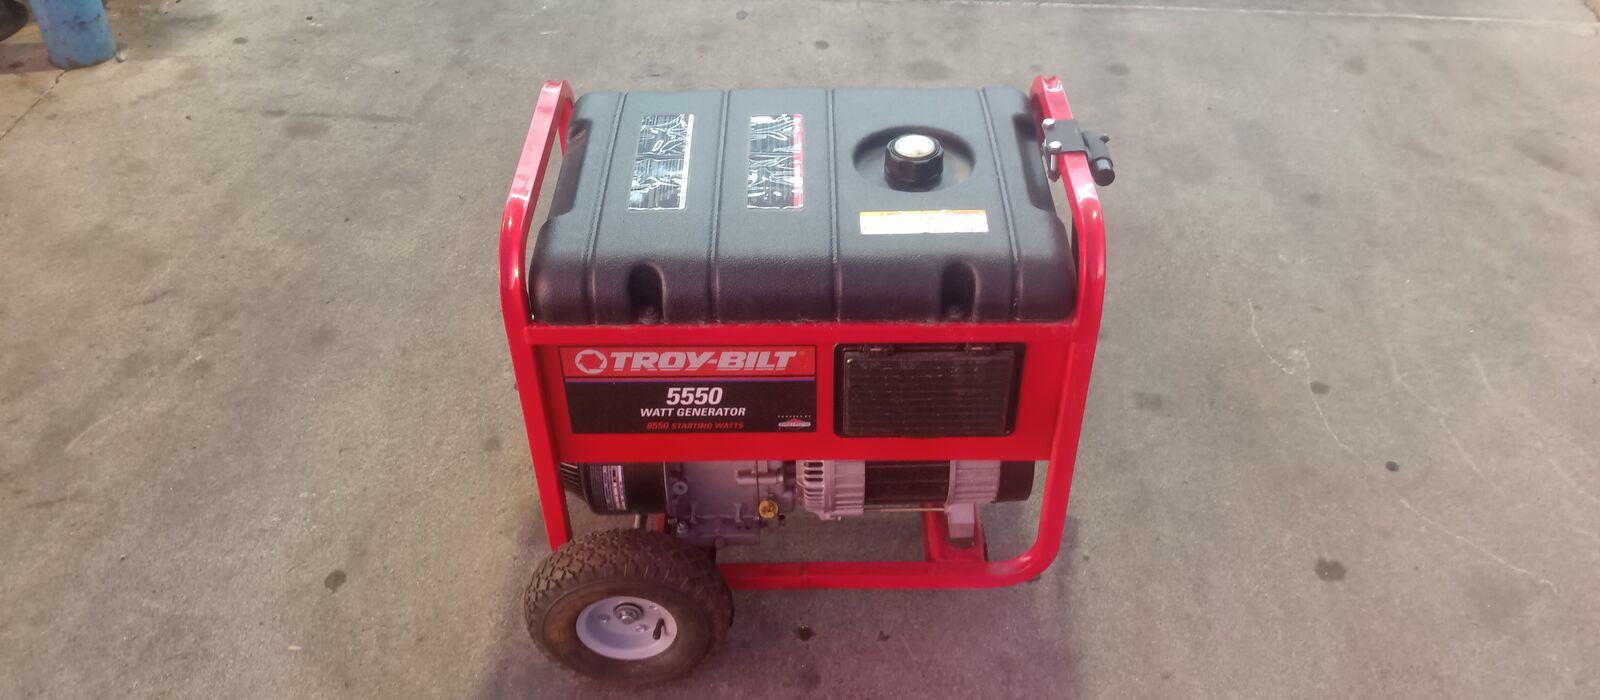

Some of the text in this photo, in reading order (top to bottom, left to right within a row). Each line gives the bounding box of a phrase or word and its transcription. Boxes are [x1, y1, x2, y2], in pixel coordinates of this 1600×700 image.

[611, 351, 797, 372] TROY-BILT
[666, 387, 723, 406] 5550
[640, 407, 746, 417] WATT GENERATOR
[671, 422, 713, 430] STARTING
[715, 422, 745, 430] WATTS
